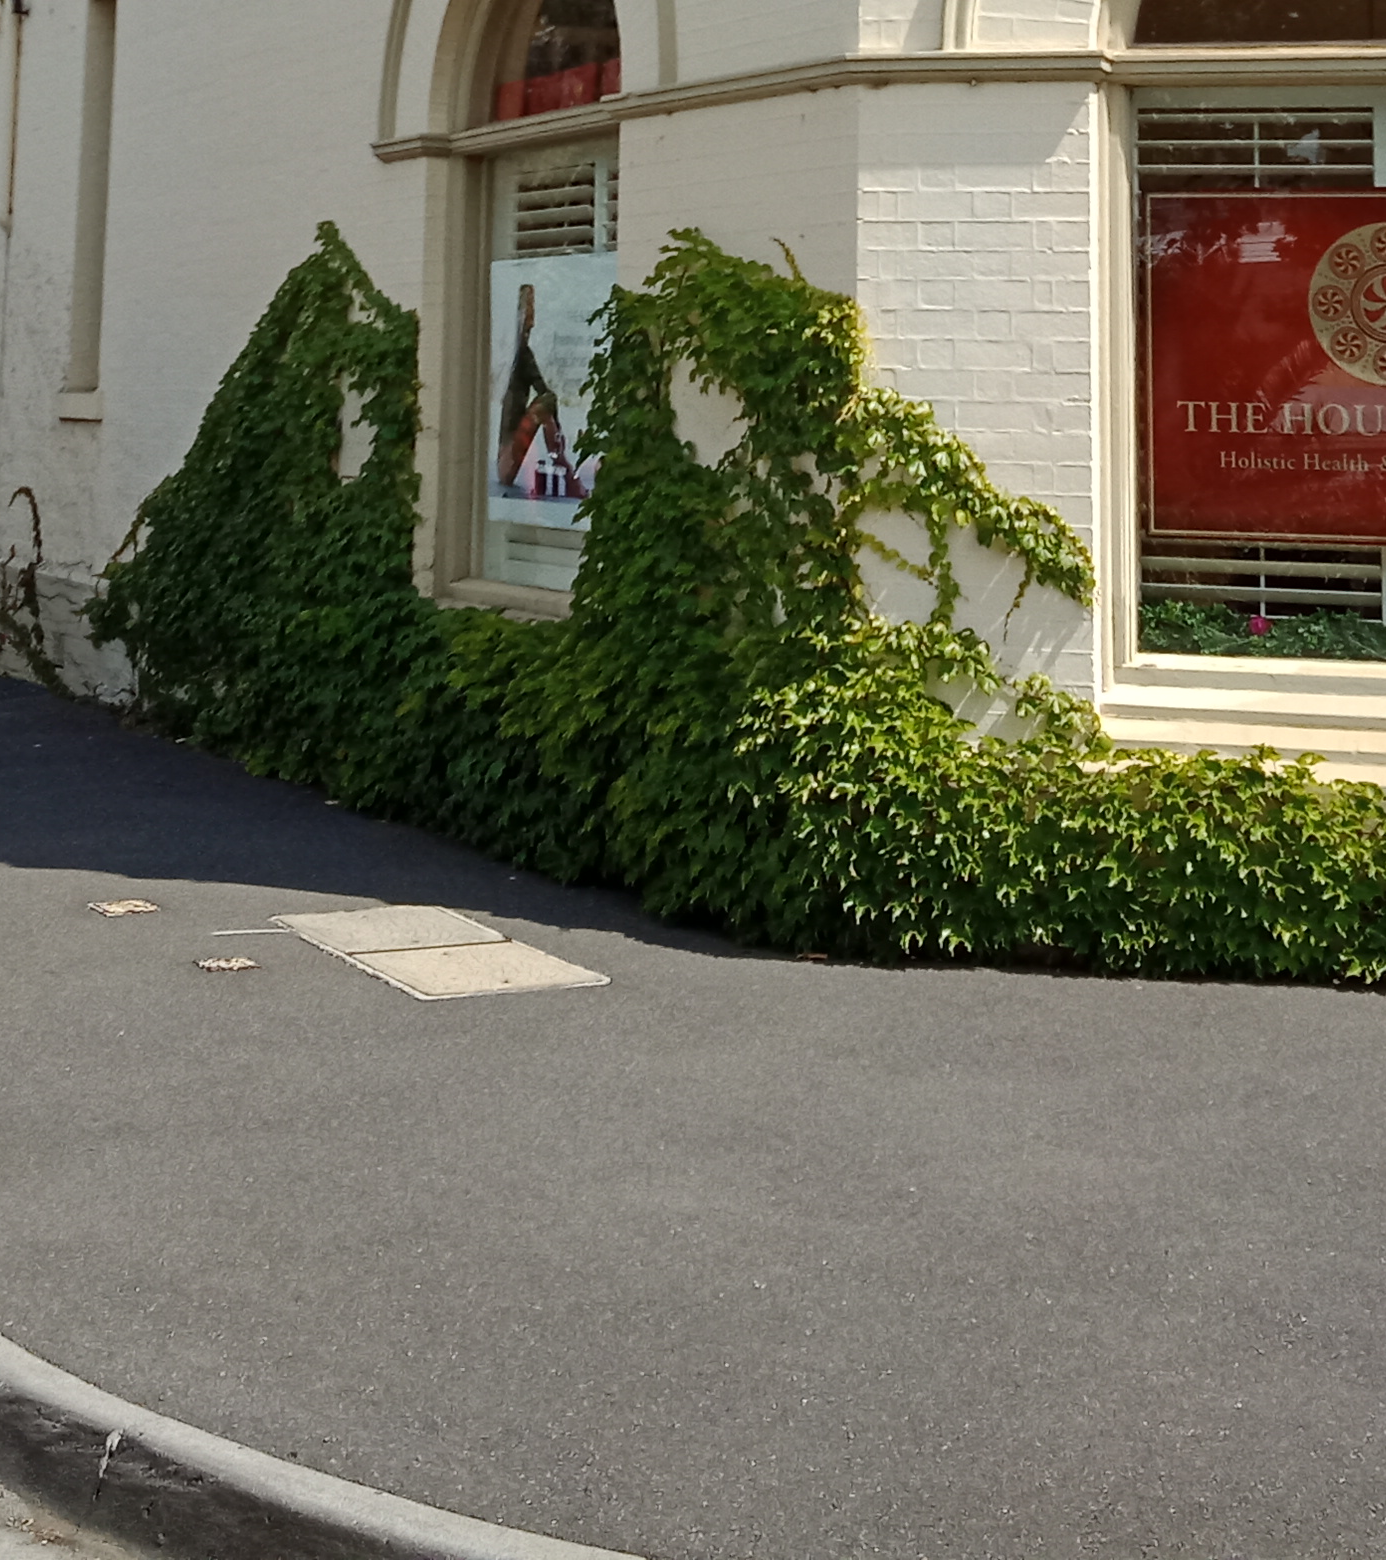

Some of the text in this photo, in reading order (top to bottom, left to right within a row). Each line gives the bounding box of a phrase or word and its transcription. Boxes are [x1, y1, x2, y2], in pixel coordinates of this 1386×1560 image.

[1176, 400, 1268, 434] THE
[1219, 450, 1296, 471] Holistic
[1303, 452, 1369, 473] Health
